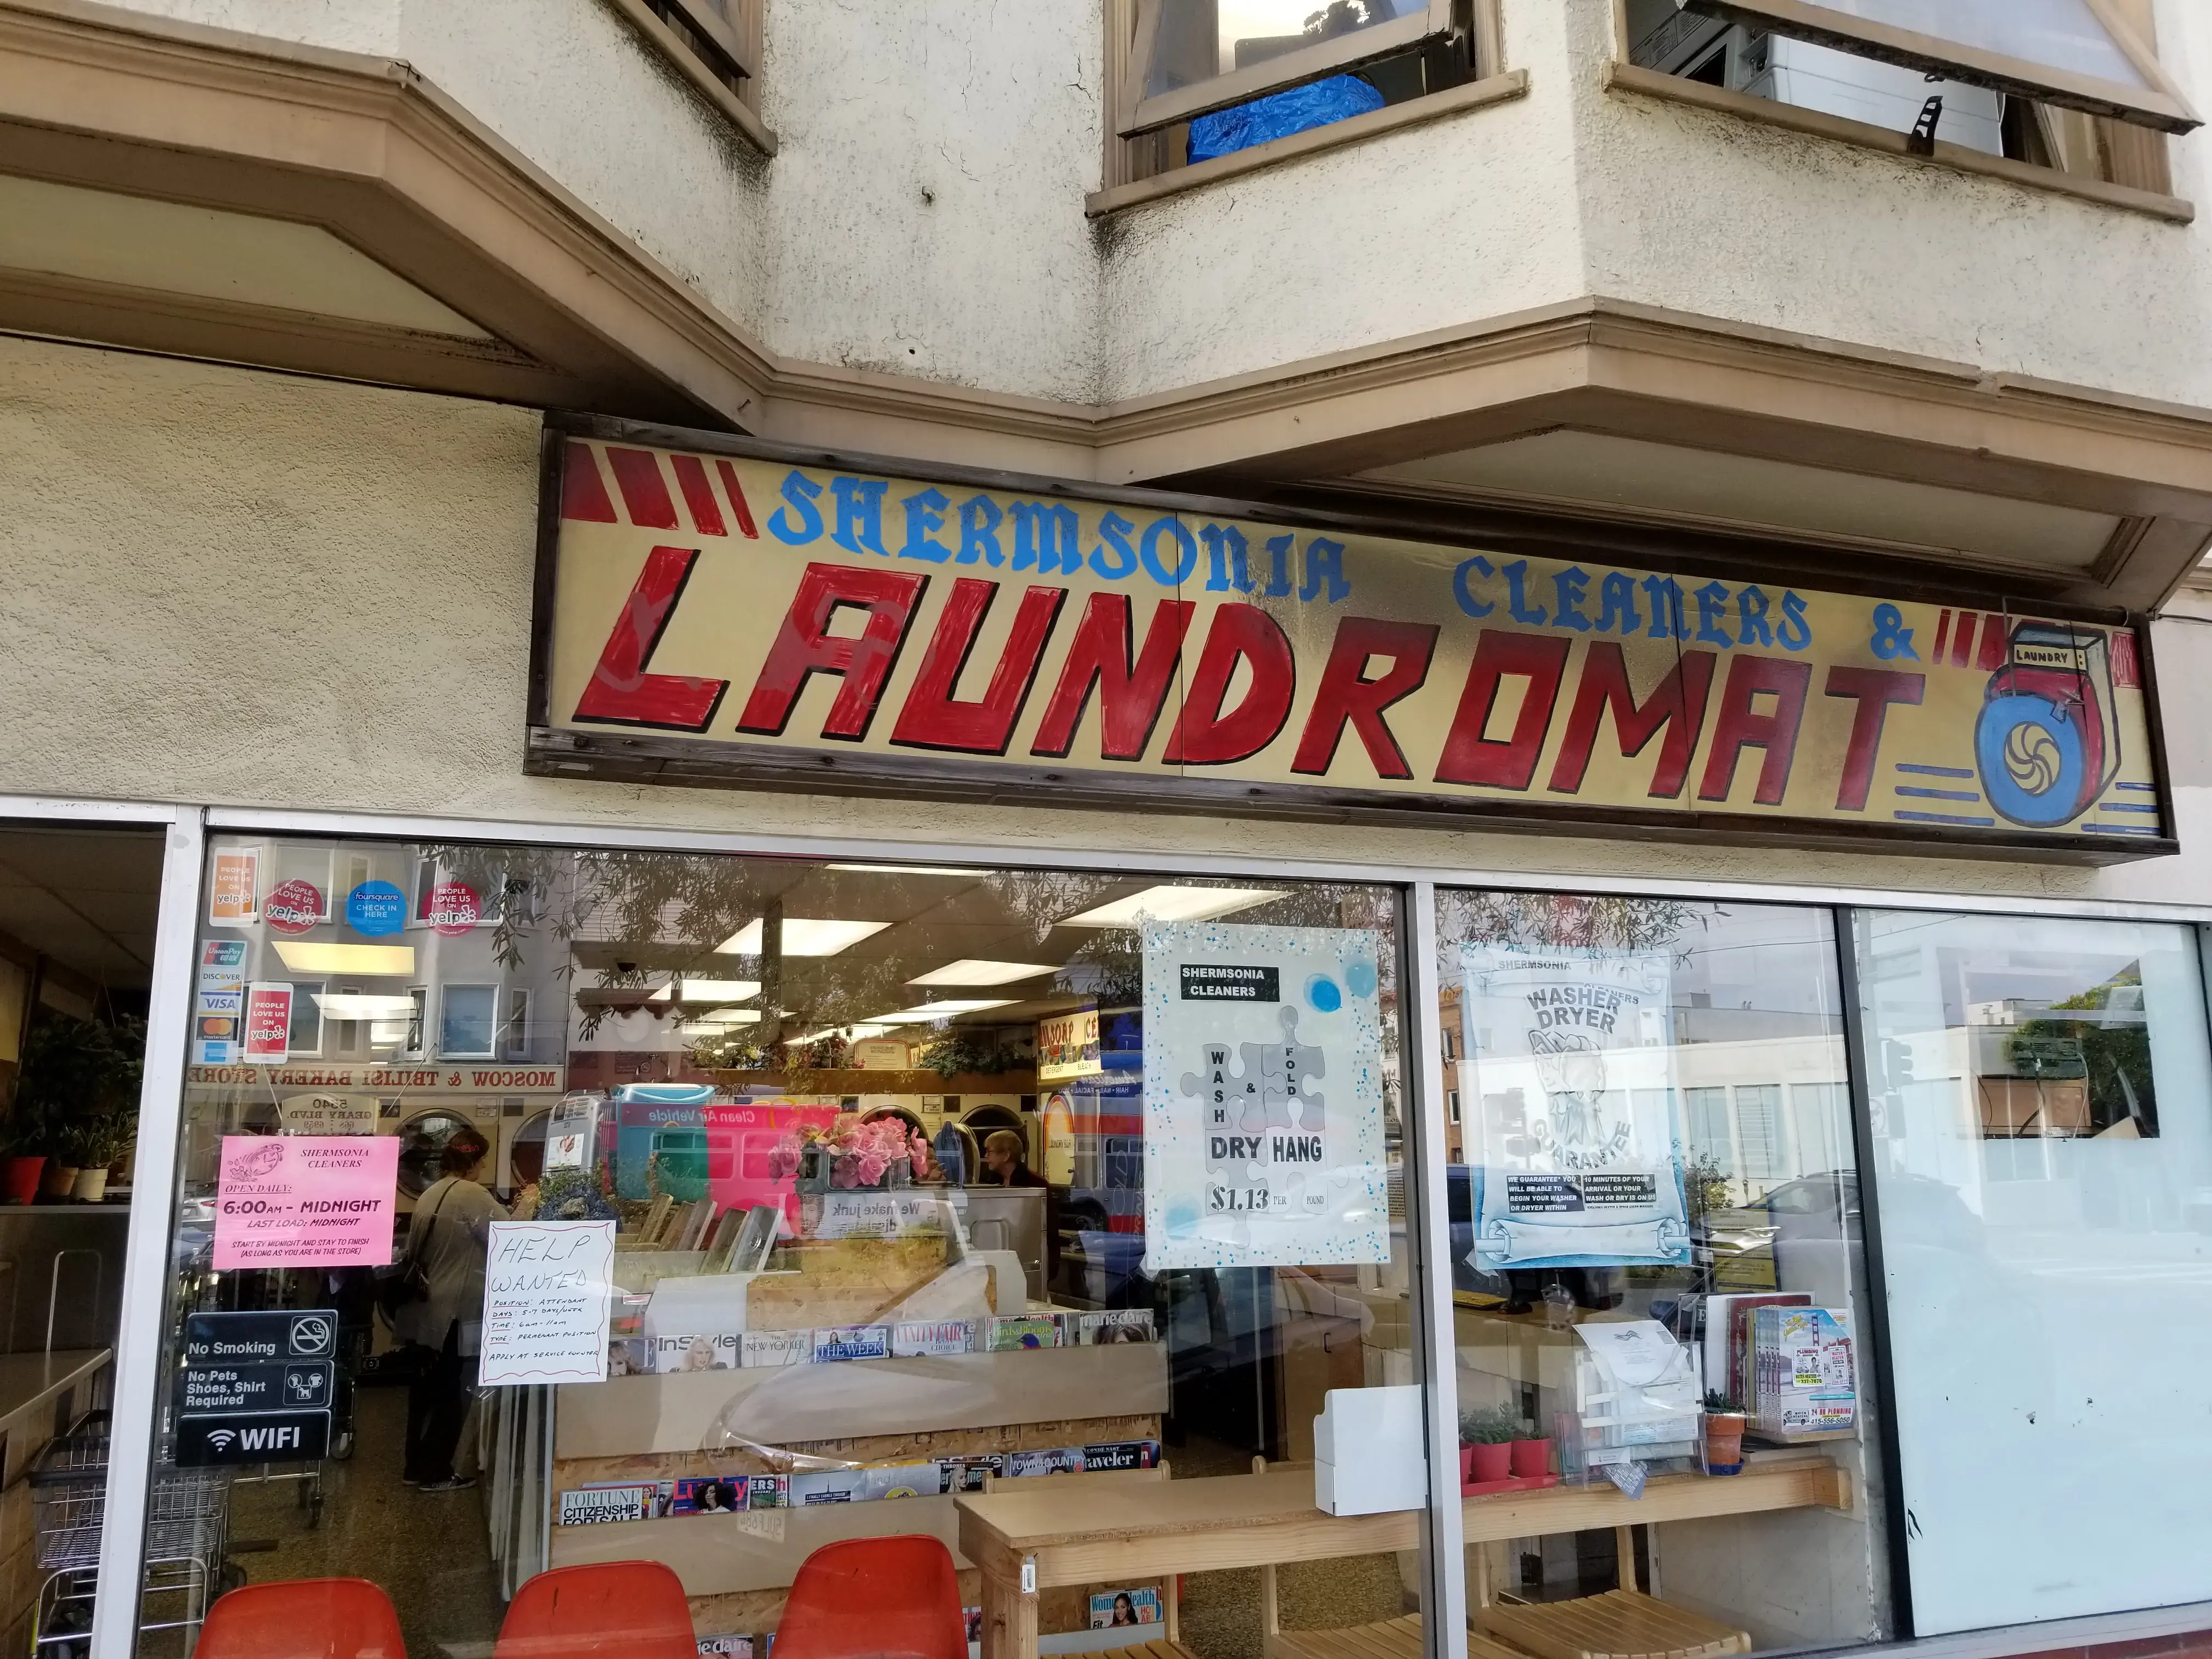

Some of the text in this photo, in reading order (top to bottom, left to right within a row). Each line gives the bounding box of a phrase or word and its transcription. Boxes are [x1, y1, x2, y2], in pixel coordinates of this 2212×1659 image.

[768, 469, 1921, 662] SHERMSONIA CLEANERS &
[2016, 650, 2067, 663] LAUNDRY
[571, 545, 1926, 811] LAUNDROMAT
[278, 889, 314, 904] LOVE US
[285, 883, 313, 896] PEOPLE
[354, 891, 399, 902] foursquare
[266, 904, 299, 923] yelp
[428, 910, 460, 926] yelp
[1498, 960, 1571, 970] SHERMSONIA
[1182, 967, 1265, 979] SHERMSONIA
[1190, 986, 1255, 996] CLEANERS
[204, 998, 235, 1009] VISA
[1526, 988, 1621, 1015] WASHER
[1536, 1007, 1616, 1035] DRYER
[251, 1029, 274, 1041] yelp
[1046, 1065, 1064, 1074] DETERGENT
[1285, 1047, 1296, 1095] FOLD
[1211, 1051, 1224, 1122] WASH
[1246, 1082, 1256, 1093] &
[301, 1149, 369, 1157] SHERMSONIA
[1211, 1136, 1322, 1162] DRY HANG
[308, 1160, 362, 1168] CLEANERS
[257, 1184, 292, 1193] DAILY:
[1211, 1185, 1324, 1212] $1.13 PER POUND
[223, 1200, 381, 1215] 6:00AM MIDNIGHT
[247, 1218, 360, 1228] LAST LOAD: MIDNIGHT
[241, 1250, 252, 1258] (AS
[498, 1235, 590, 1263] HELP
[491, 1269, 586, 1292] WANTED
[541, 1305, 583, 1316] DAYS/WEEK
[1081, 1311, 1152, 1326] marie claire
[518, 1332, 559, 1340] PERMENANT
[896, 1325, 961, 1342] VANITY FAIR
[189, 1341, 275, 1356] No Smoking
[747, 1340, 804, 1352] NEW YORKER
[818, 1342, 883, 1357] THE WEEK
[188, 1370, 238, 1381] No Pets
[187, 1381, 266, 1395] Shoes, Shirt
[186, 1394, 244, 1408] Required
[240, 1426, 300, 1450] WIFI
[566, 1489, 639, 1507] FORTUNE
[564, 1504, 639, 1518] CITIZENSHIP
[713, 1639, 752, 1653] claire
